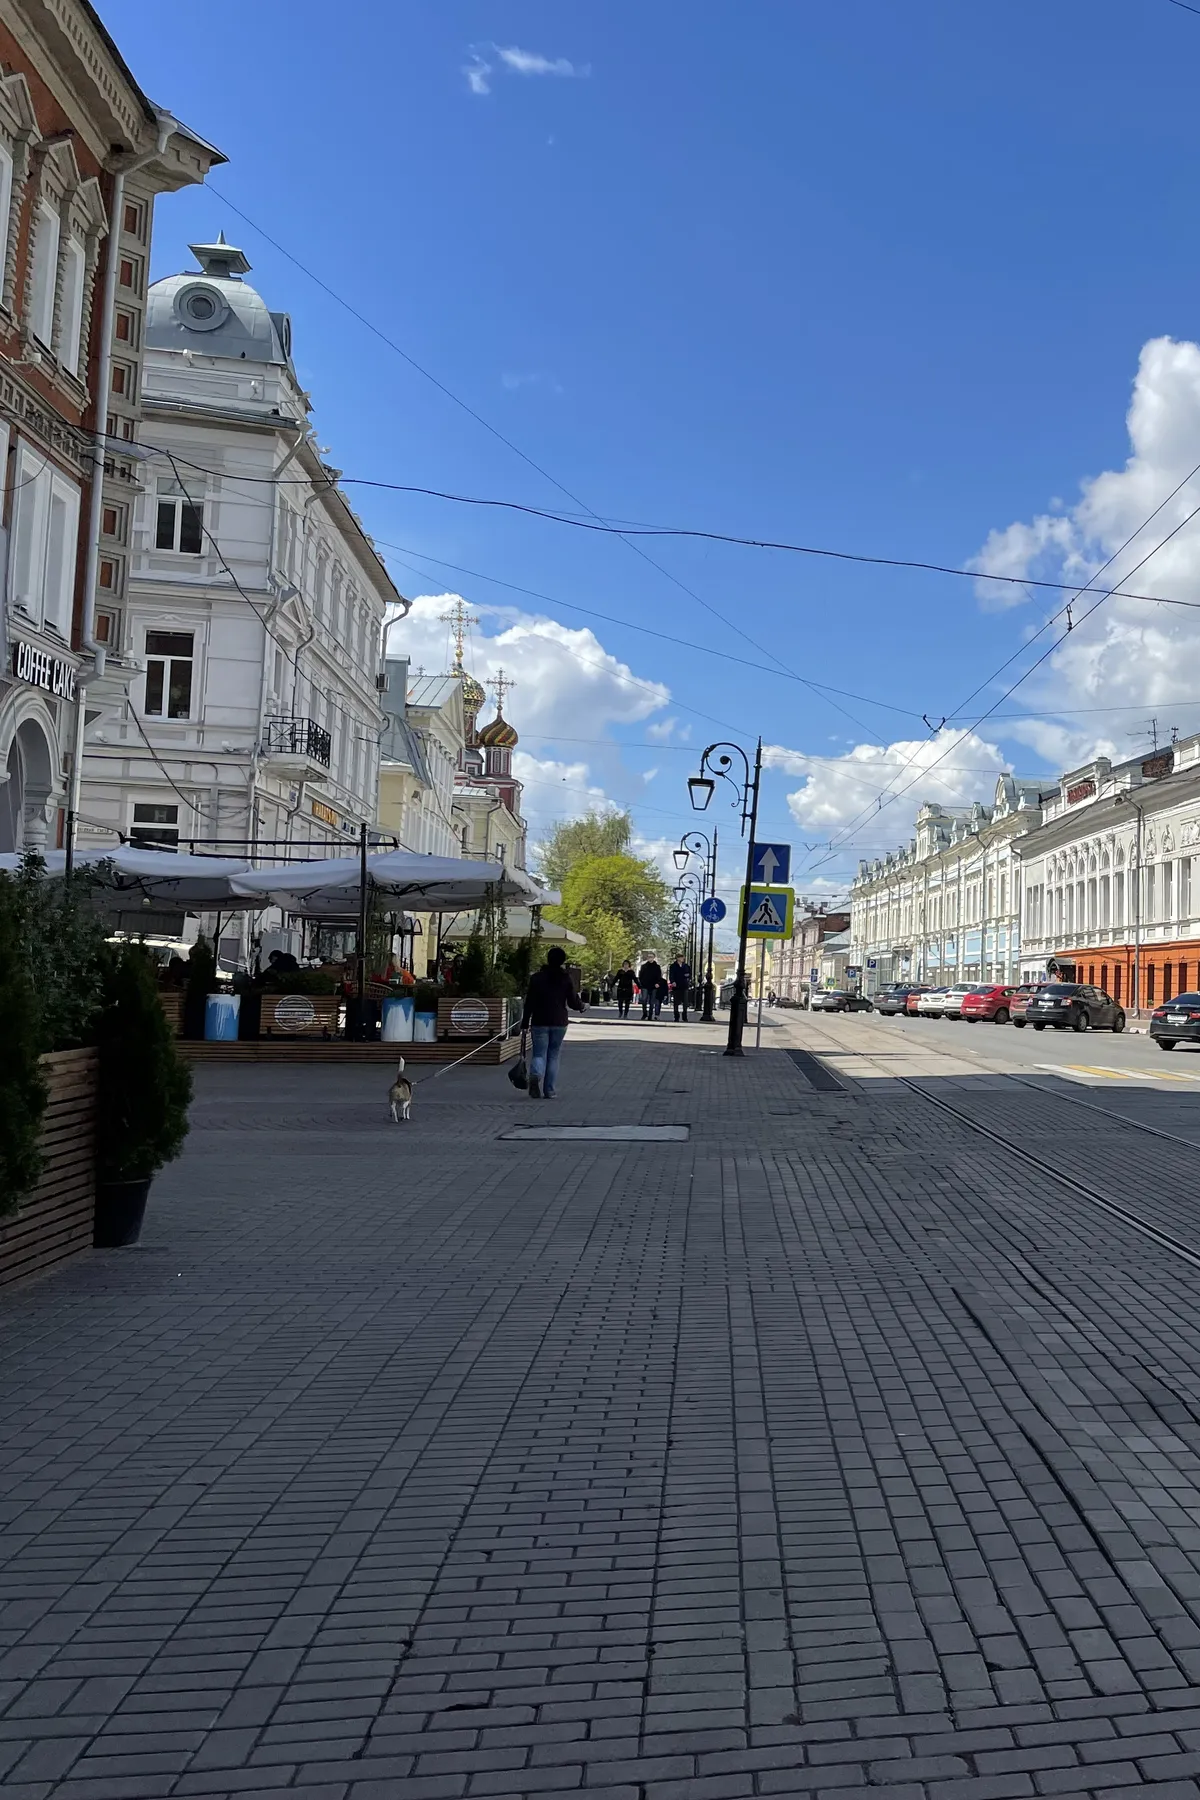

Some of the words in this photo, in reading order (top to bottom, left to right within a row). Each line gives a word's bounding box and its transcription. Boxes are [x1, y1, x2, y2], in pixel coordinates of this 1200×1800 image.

[17, 641, 52, 691] COFFEE
[52, 659, 76, 702] CAKE
[869, 960, 876, 968] P
[849, 970, 855, 978] P
